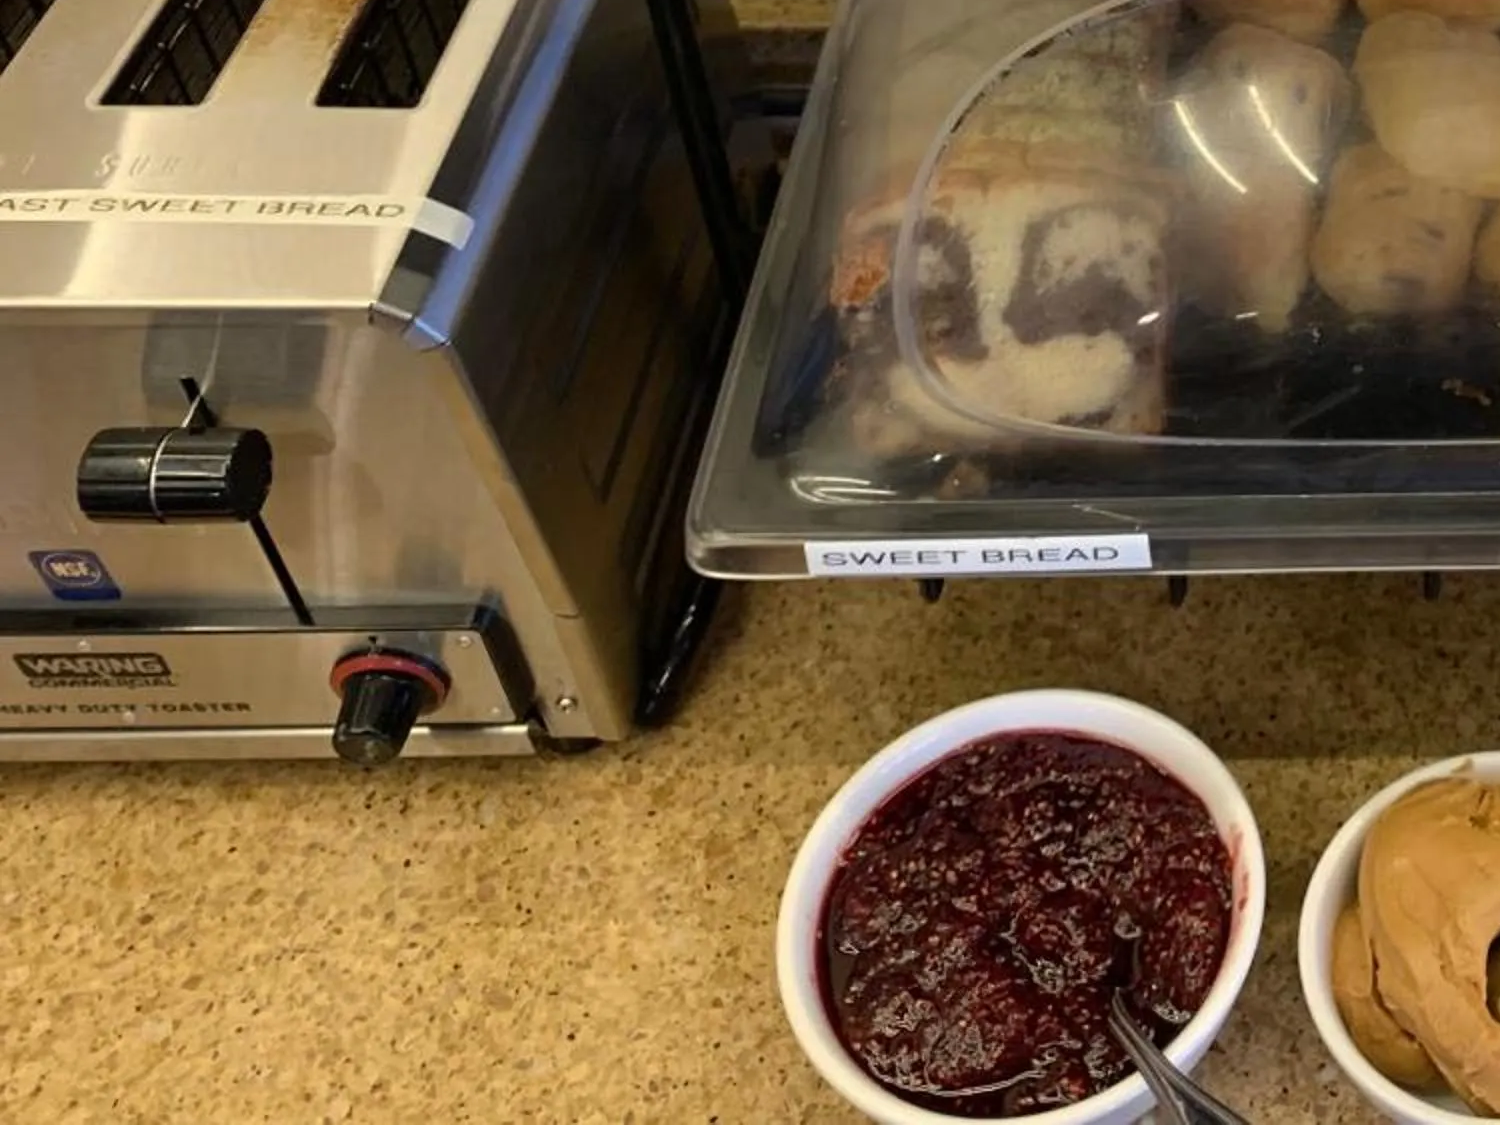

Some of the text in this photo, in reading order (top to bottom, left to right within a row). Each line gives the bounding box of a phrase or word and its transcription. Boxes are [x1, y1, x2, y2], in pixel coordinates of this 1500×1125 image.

[88, 197, 247, 214] SWEET
[256, 201, 406, 219] BREAD
[821, 546, 1121, 567] SWEET BREAD
[50, 560, 91, 577] NSF
[20, 656, 164, 676] WARING
[28, 676, 178, 689] COMMERCIAL
[0, 700, 253, 715] HEAVY DUTY TOASTER
